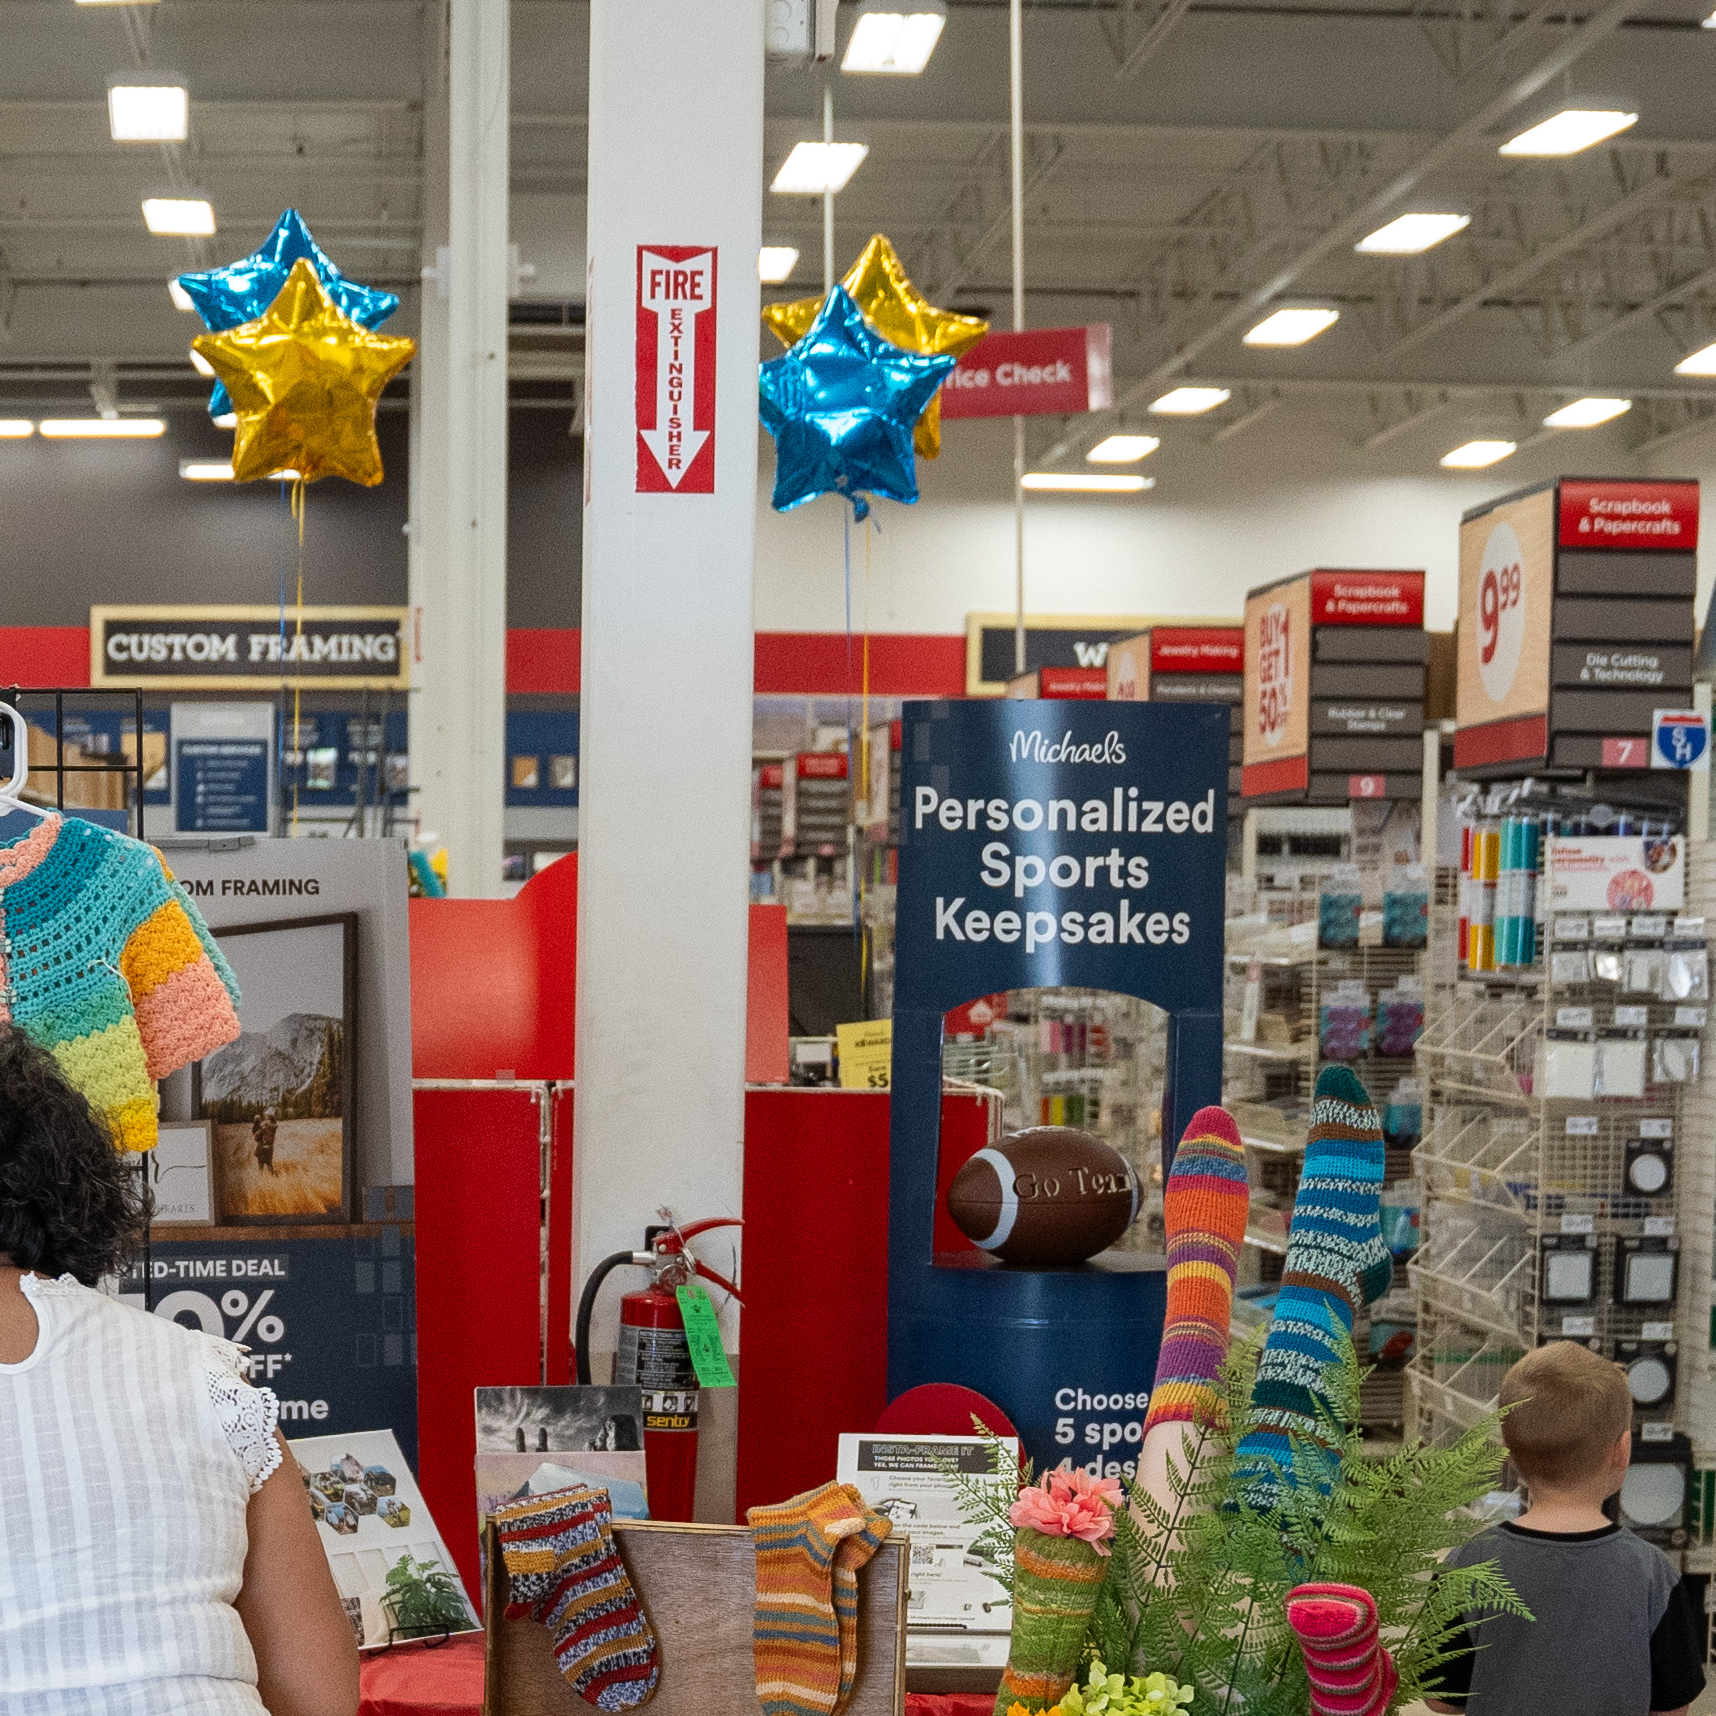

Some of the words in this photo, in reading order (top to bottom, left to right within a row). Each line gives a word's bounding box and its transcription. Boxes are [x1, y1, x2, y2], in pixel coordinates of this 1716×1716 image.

[650, 269, 704, 301] FIRE
[945, 365, 990, 390] rice
[995, 359, 1072, 387] Check
[668, 308, 683, 470] EXTINGUISHER
[1589, 498, 1672, 516] Scrapbook
[1579, 517, 1590, 534] &
[1594, 517, 1682, 536] Papercrafts
[1334, 584, 1401, 599] Scrapbook
[1338, 600, 1409, 615] Papercrafts
[107, 633, 238, 662] CUSTOM
[249, 633, 395, 662] FRAMING
[1587, 653, 1608, 667] Die
[1611, 653, 1659, 670] Cutting
[1594, 667, 1664, 685] Technology
[1009, 730, 1127, 765] Michaels
[1618, 741, 1633, 763] 7
[1360, 776, 1375, 797] 9
[914, 786, 1215, 833] Personalized
[980, 844, 1150, 897] Sports
[222, 879, 320, 896] FRAMING
[935, 898, 1191, 953] Keepsakes
[867, 1073, 889, 1088] $5
[1013, 1172, 1059, 1200] Go
[129, 1259, 227, 1278] TED-TIME
[232, 1259, 286, 1276] DEAL
[249, 1352, 292, 1379] FF
[1055, 1387, 1148, 1411] Choose
[647, 1414, 689, 1428] sentry
[1055, 1418, 1075, 1444] 5
[1084, 1422, 1144, 1450] spo
[872, 1444, 959, 1456] INSTA-FRAME
[961, 1445, 975, 1456] IT
[1084, 1454, 1141, 1479] desi
